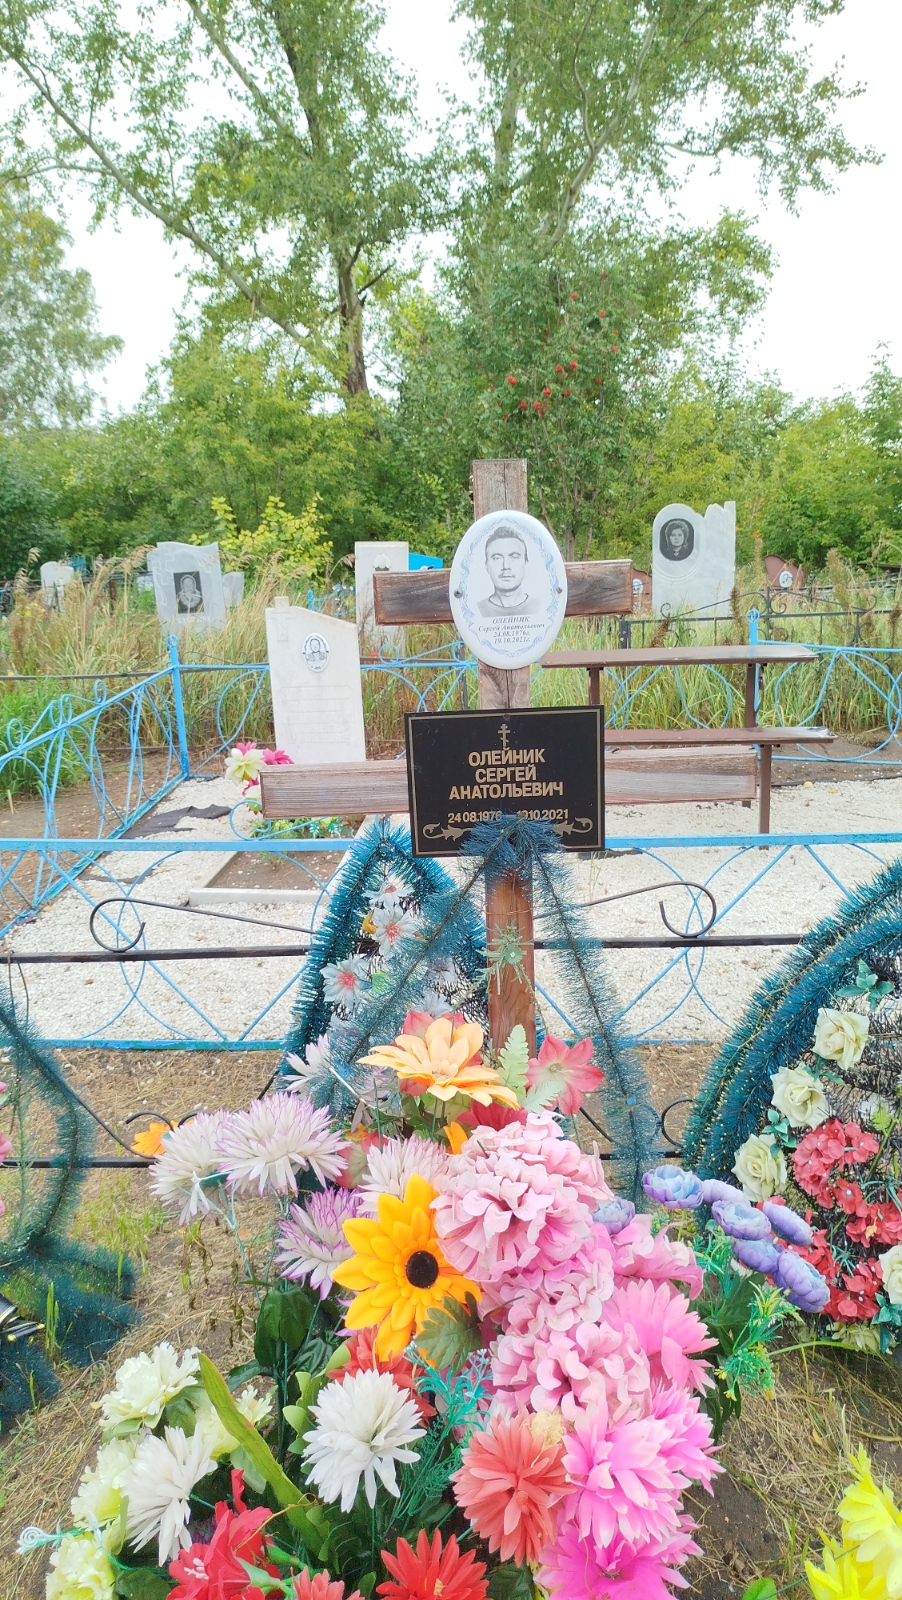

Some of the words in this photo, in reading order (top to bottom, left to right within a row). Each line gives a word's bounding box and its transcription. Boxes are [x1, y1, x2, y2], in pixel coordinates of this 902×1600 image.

[492, 616, 530, 624] ОЛЕЙНИК
[468, 747, 546, 767] ОЛЕЙНИК
[475, 764, 537, 783] СЕРГЕЙ
[449, 782, 564, 800] АНАТОЛЬЕВИЧ
